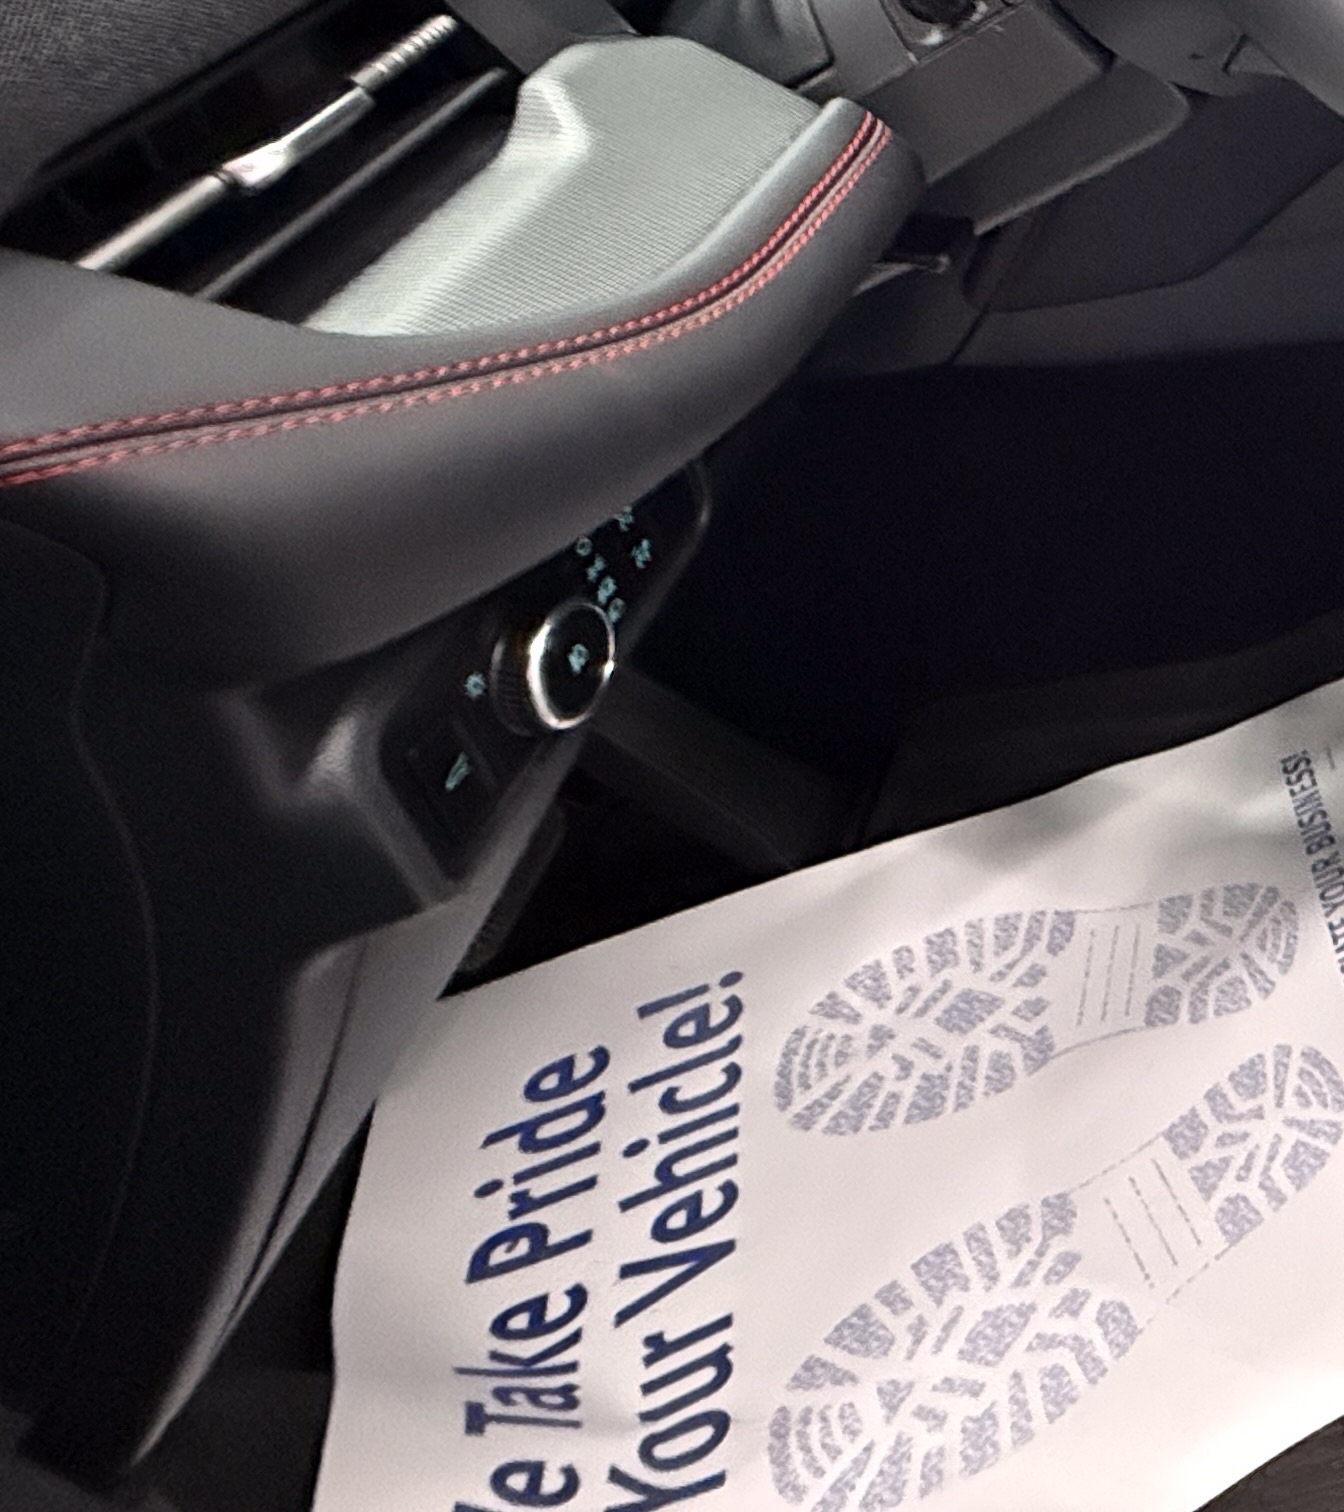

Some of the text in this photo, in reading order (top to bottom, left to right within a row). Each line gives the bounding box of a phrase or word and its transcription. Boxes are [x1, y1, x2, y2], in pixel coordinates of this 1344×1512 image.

[1280, 750, 1337, 857] BUSINESS!
[453, 1045, 610, 1512] e Take Pride
[603, 970, 744, 1512] Your Vehicle!
